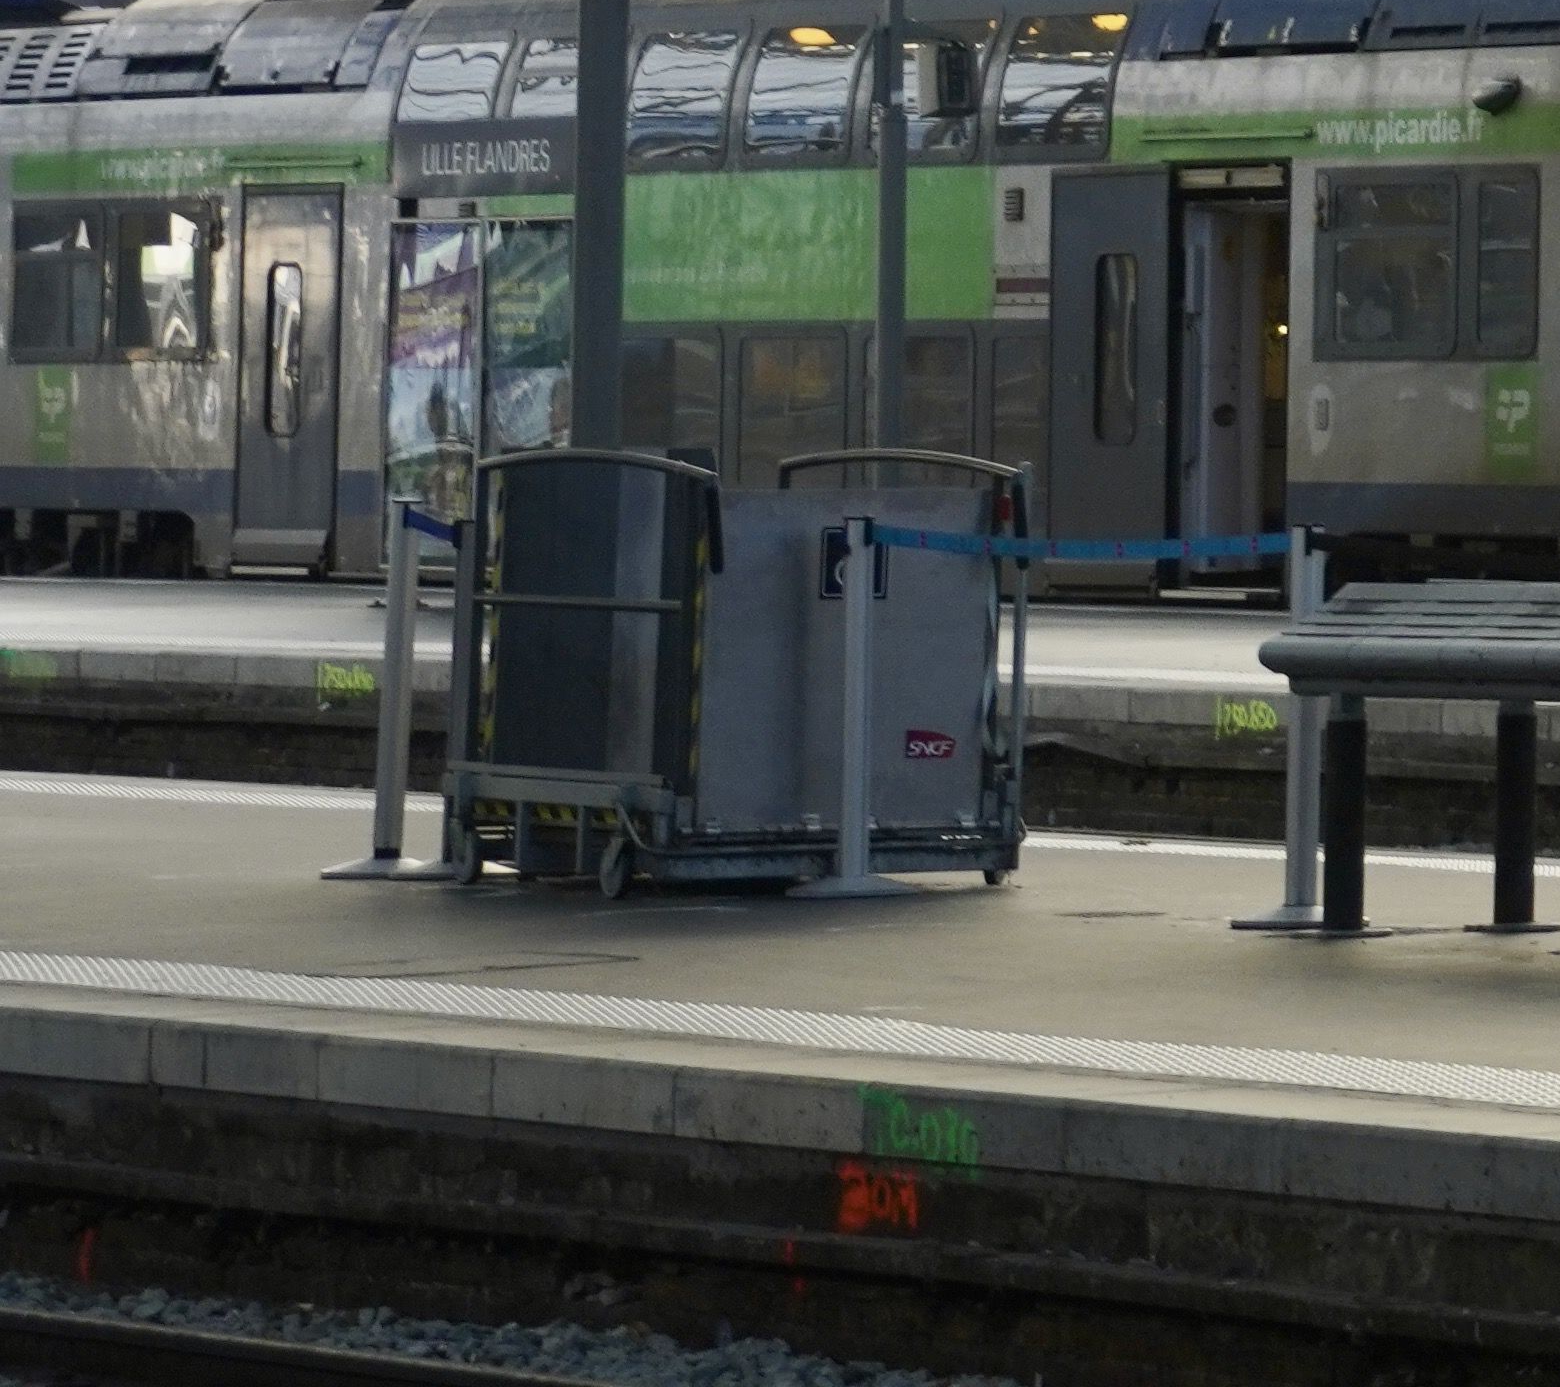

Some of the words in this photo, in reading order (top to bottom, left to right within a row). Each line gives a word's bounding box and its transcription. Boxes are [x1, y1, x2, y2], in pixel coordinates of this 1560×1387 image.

[1317, 109, 1482, 153] www.picardie.fr
[422, 141, 463, 176] LILLE
[464, 138, 551, 175] FLANDRES
[908, 740, 954, 756] SNCF
